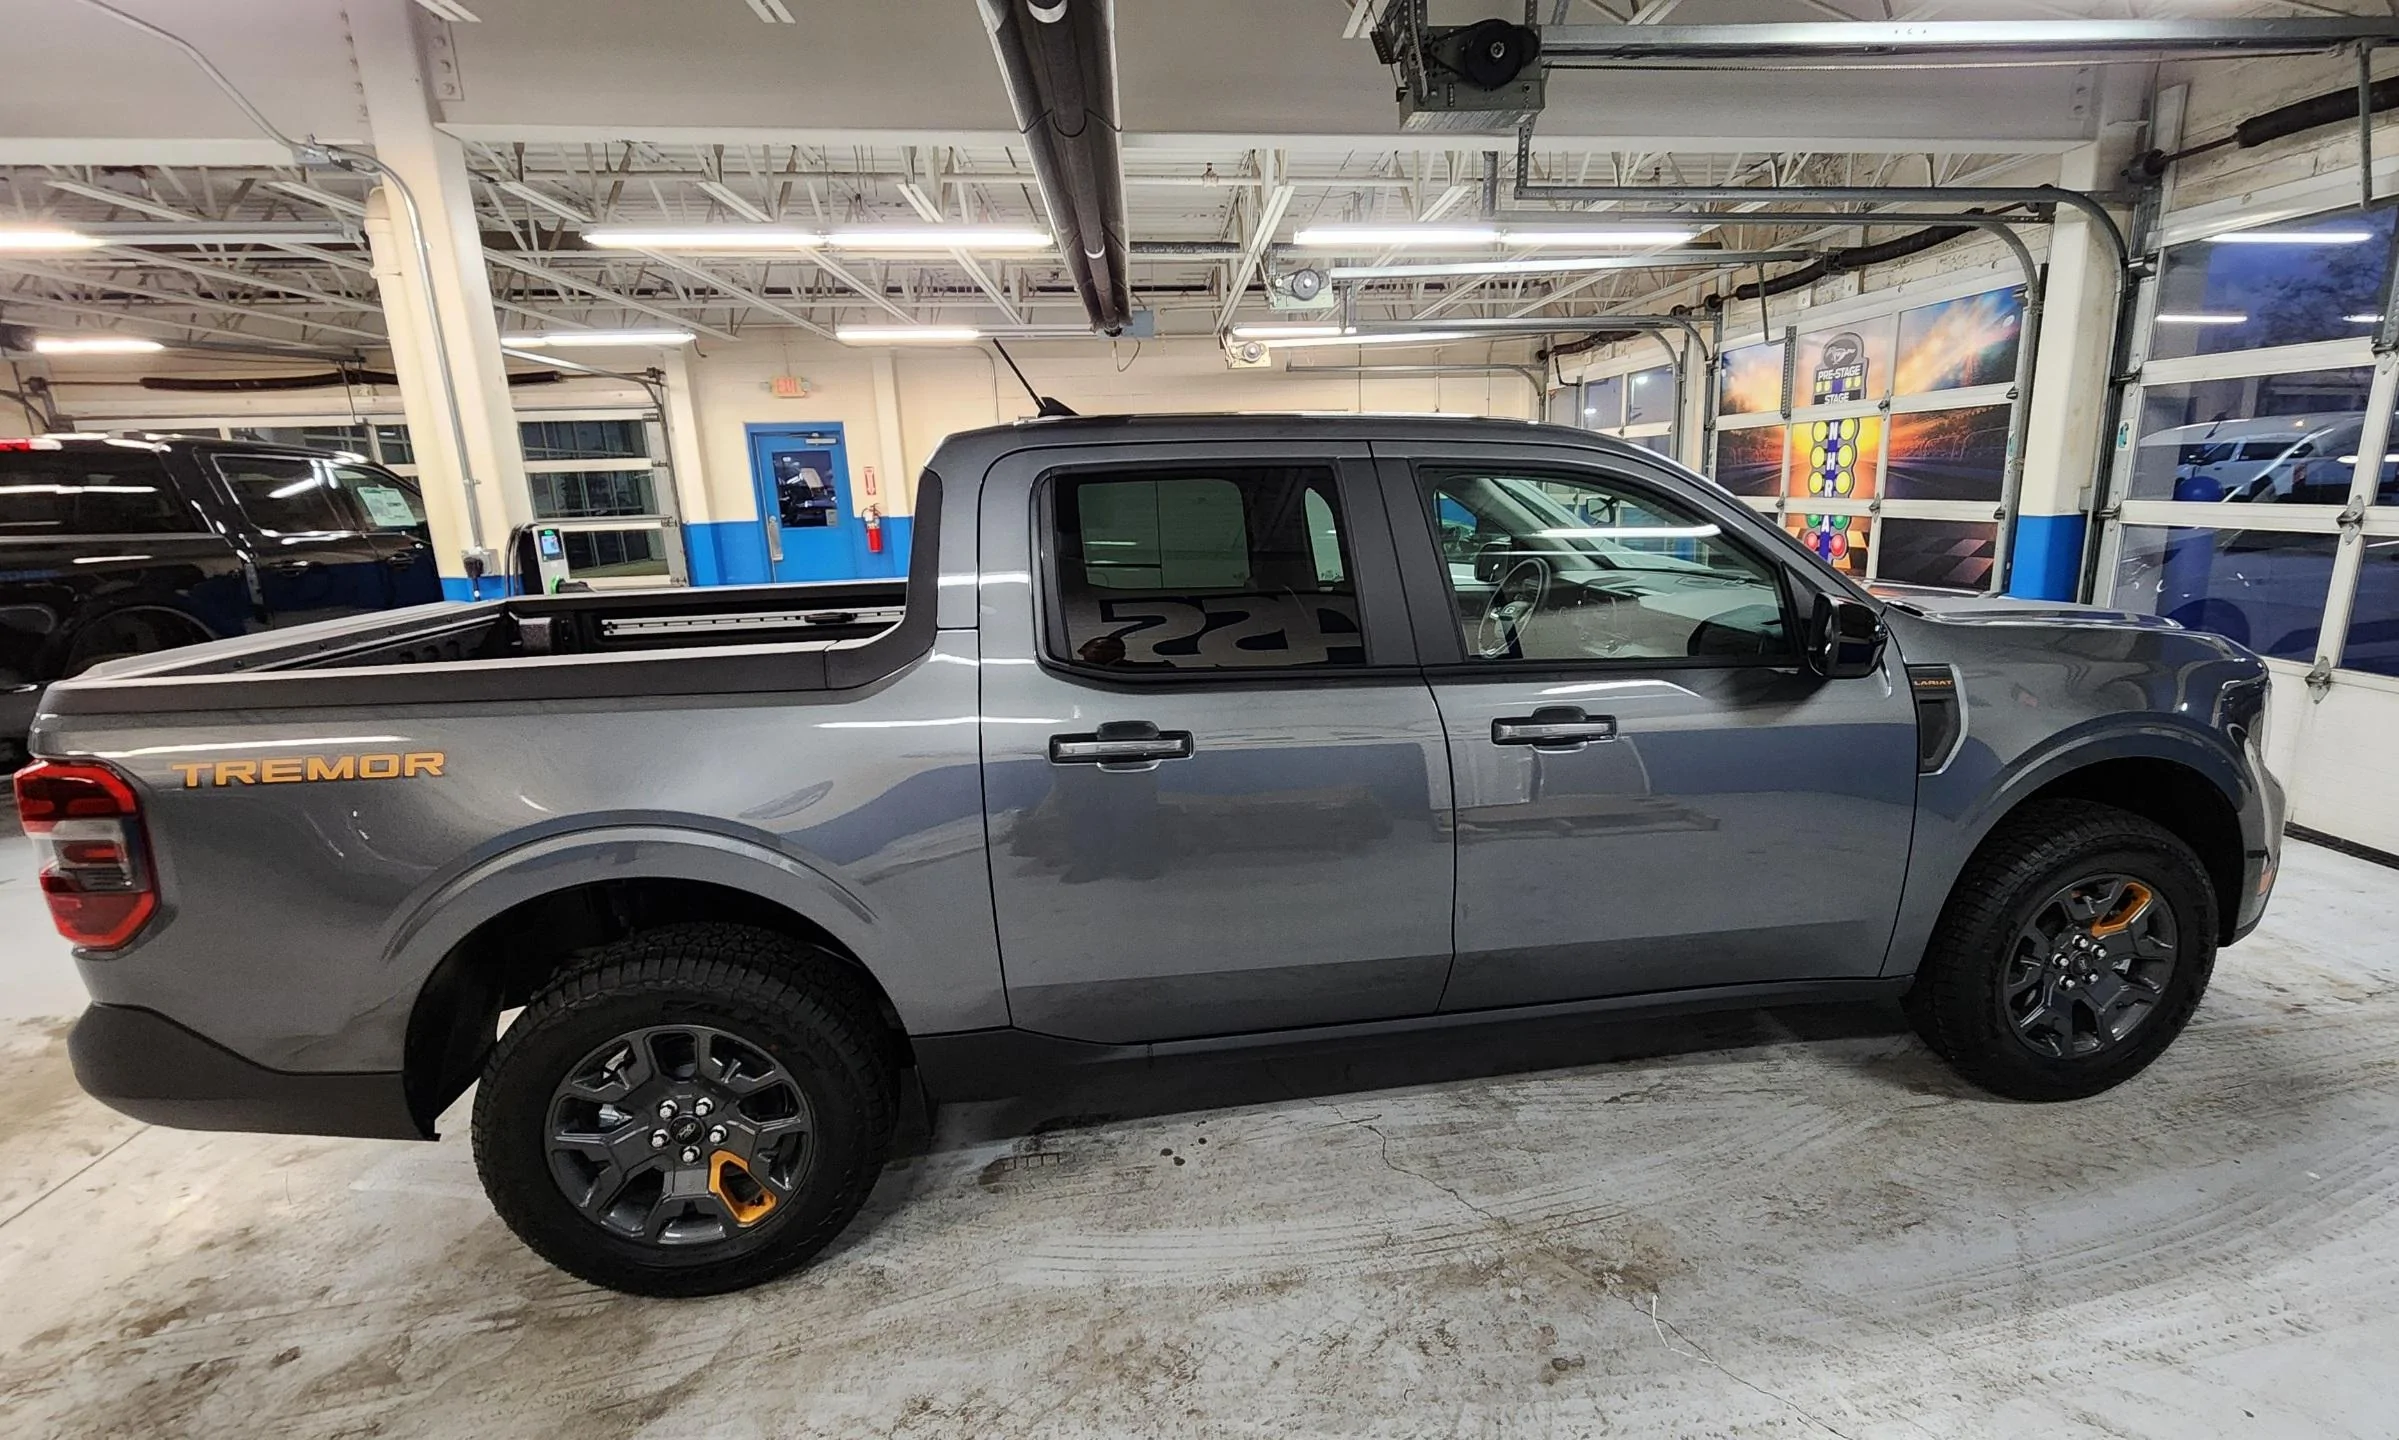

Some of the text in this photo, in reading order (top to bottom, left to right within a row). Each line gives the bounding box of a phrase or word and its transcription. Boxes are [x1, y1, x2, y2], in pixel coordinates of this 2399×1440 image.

[1817, 365, 1861, 381] PRE-STAGE
[1824, 392, 1850, 405] STAGE
[171, 752, 445, 788] TREMOR
